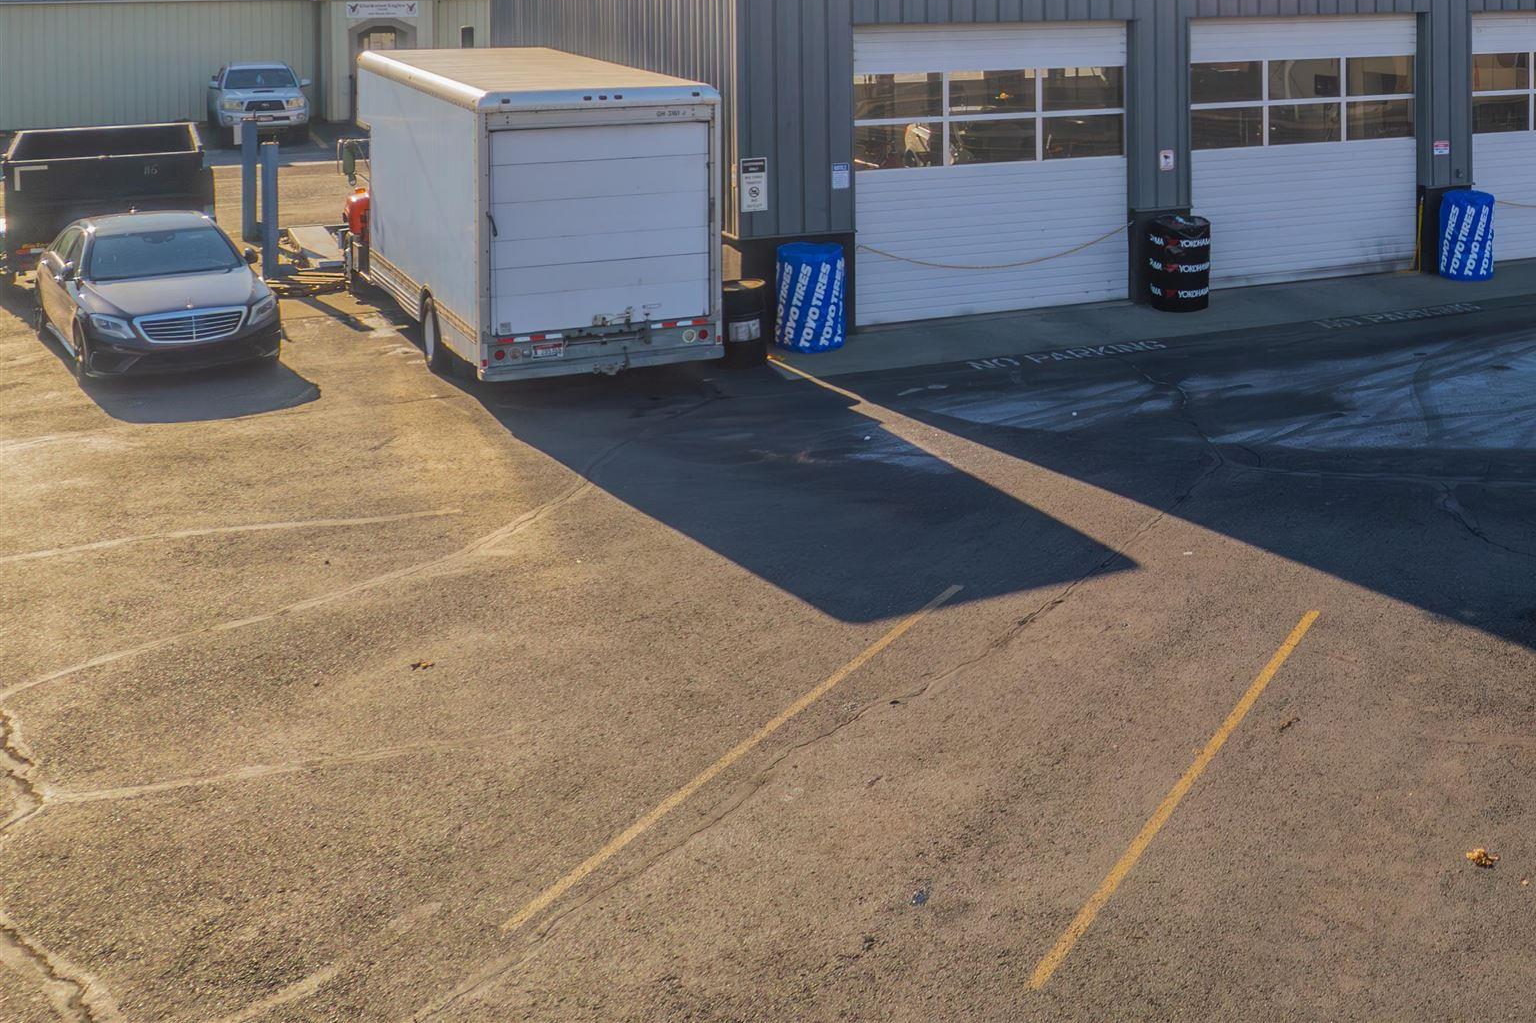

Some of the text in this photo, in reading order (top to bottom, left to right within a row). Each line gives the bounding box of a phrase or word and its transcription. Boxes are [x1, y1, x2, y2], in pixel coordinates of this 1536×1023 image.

[1450, 205, 1475, 275] TOYO TIRES
[1464, 205, 1489, 276] TOYO TIRES
[792, 263, 812, 307] TIRES
[799, 262, 831, 347] TOYO TIRES
[820, 304, 836, 346] TOYO
[966, 340, 1168, 370] NO PARKING
